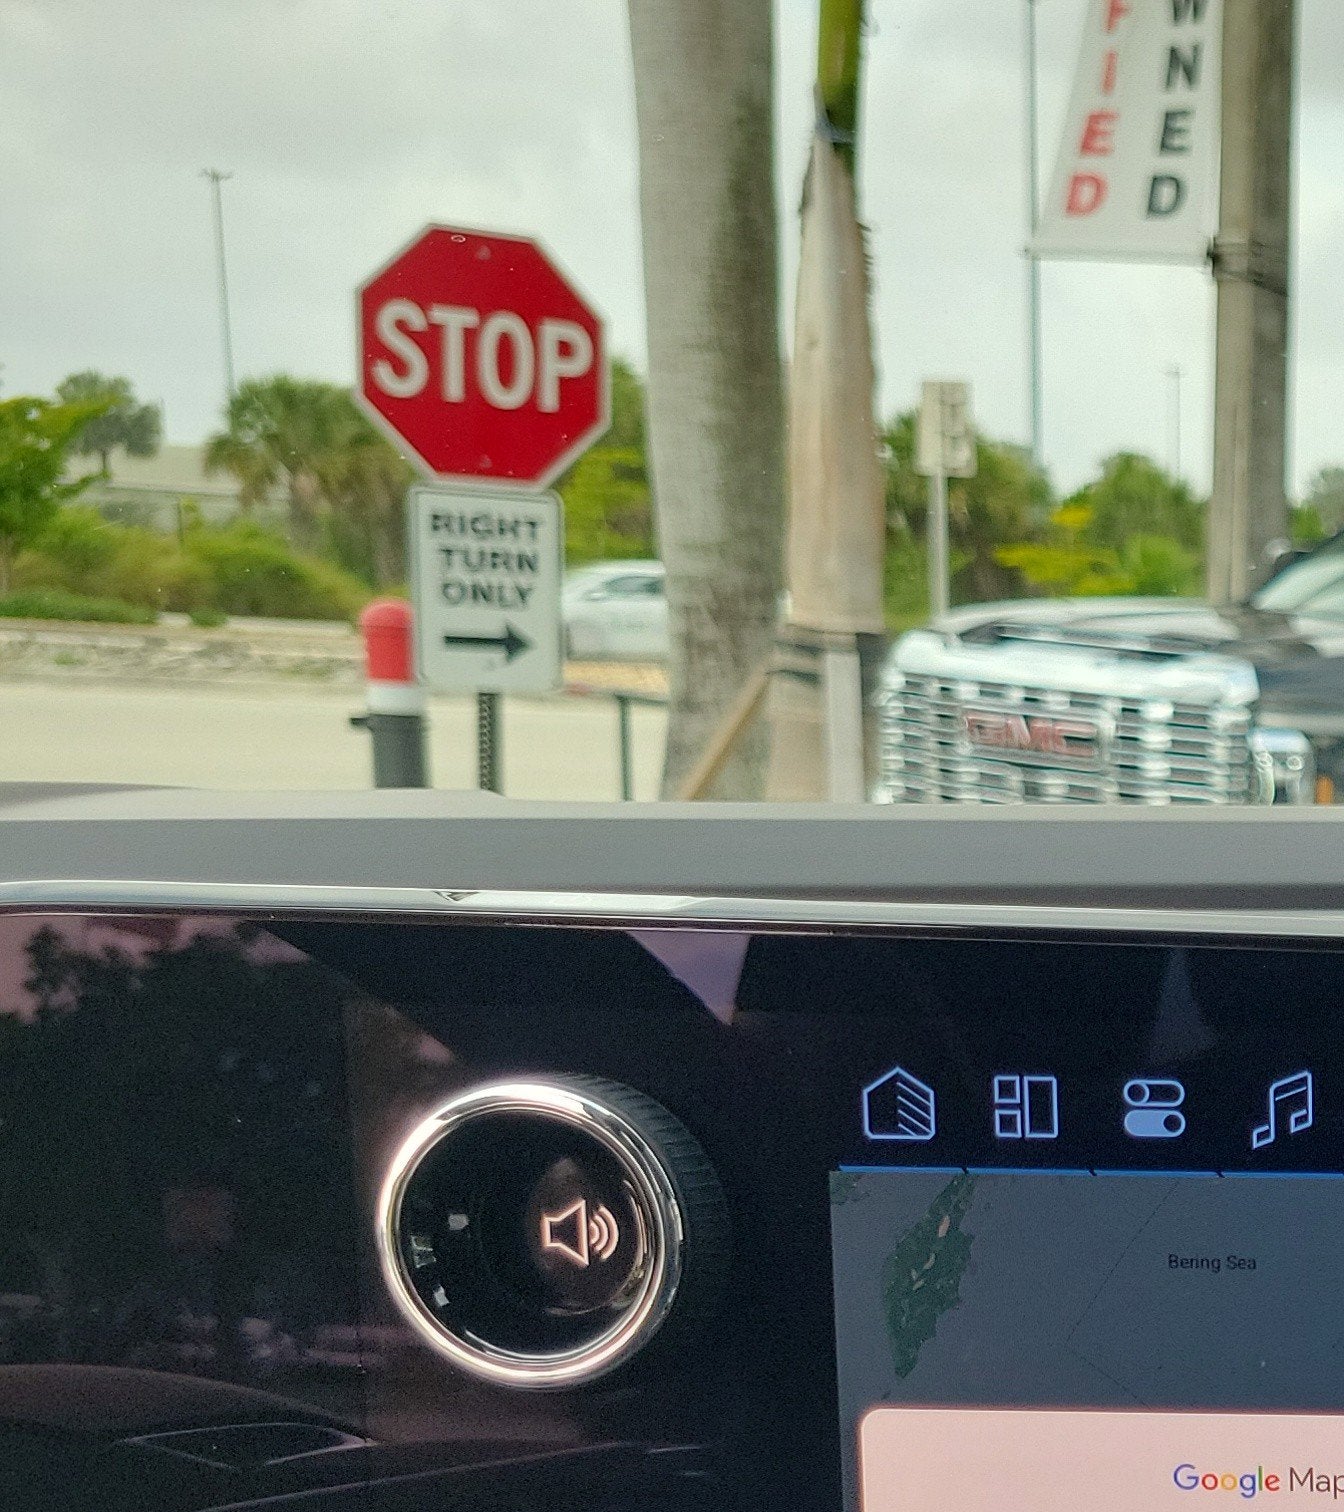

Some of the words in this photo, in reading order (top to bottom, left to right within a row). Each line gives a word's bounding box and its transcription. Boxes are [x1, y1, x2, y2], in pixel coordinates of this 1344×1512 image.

[371, 298, 594, 413] STOP
[430, 510, 544, 537] RIGHT
[440, 549, 539, 572] TURN
[441, 582, 533, 608] ONLY
[1168, 1253, 1222, 1273] Bering
[1226, 1254, 1257, 1271] Sea
[1172, 1463, 1281, 1498] Google
